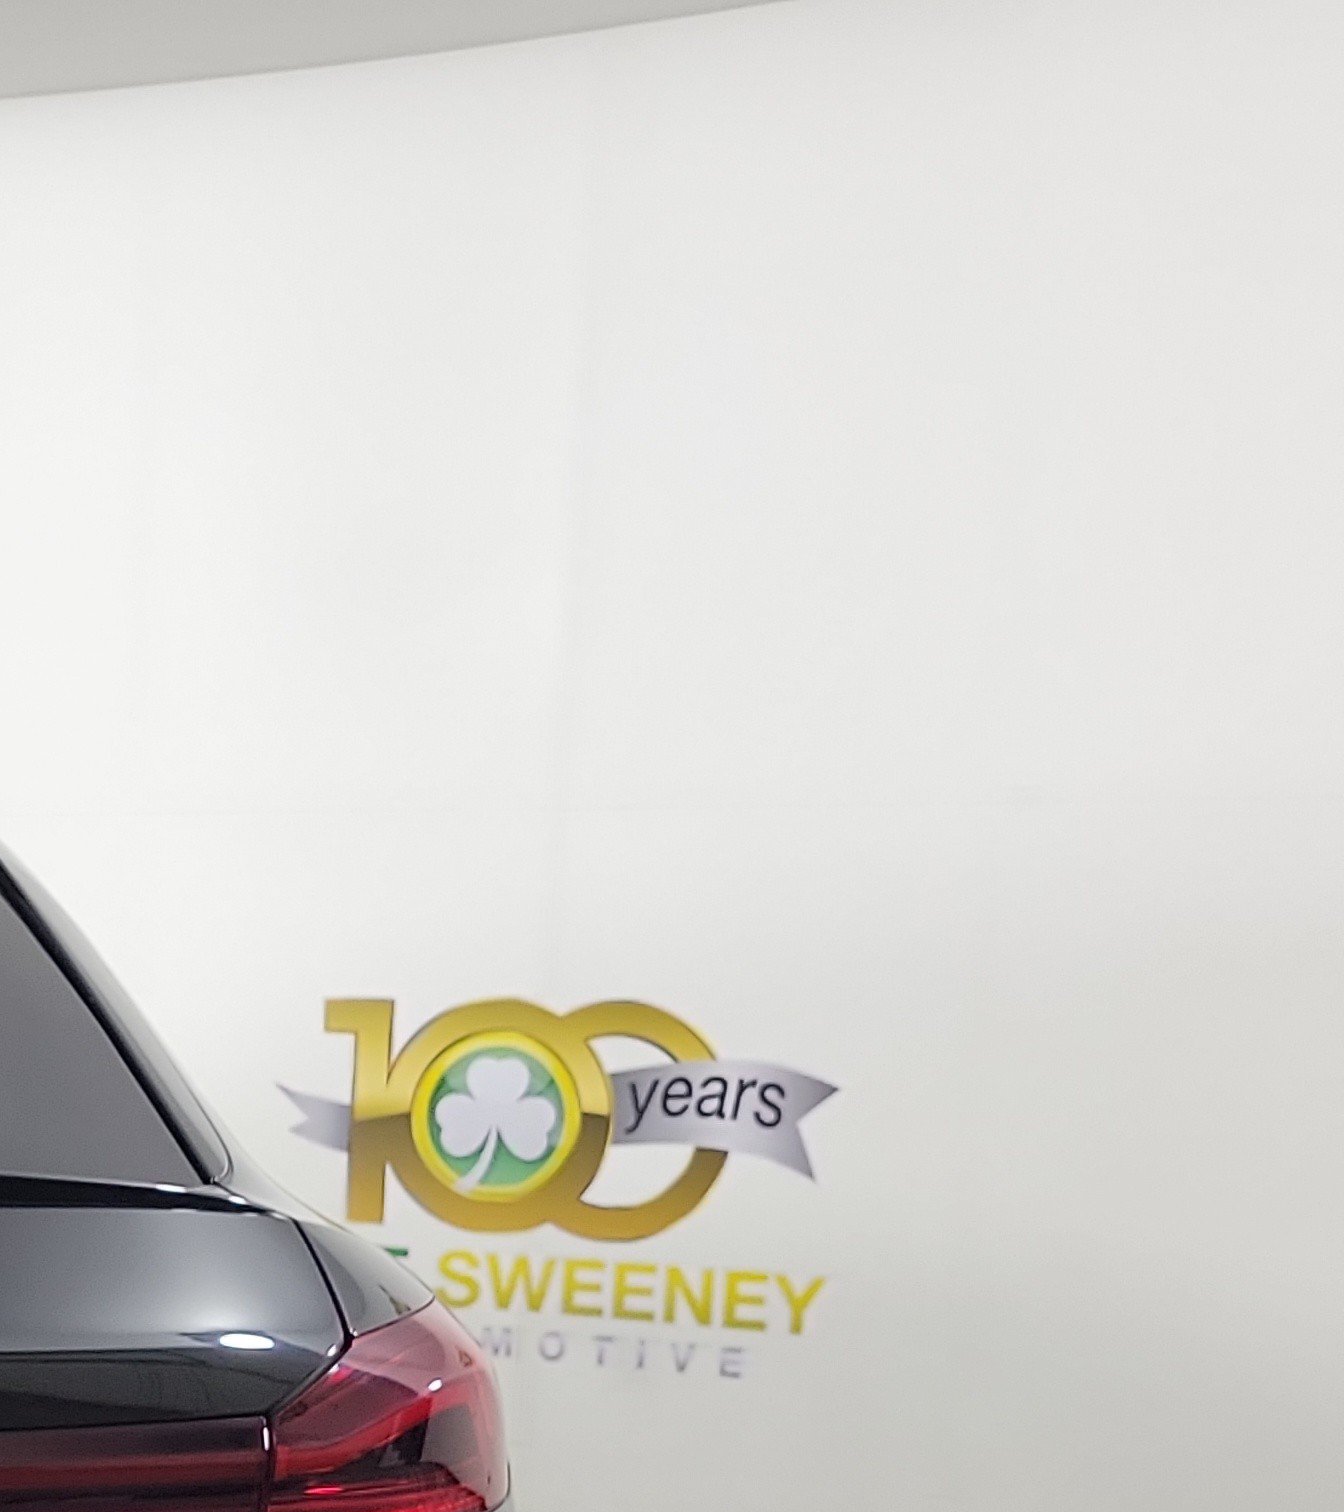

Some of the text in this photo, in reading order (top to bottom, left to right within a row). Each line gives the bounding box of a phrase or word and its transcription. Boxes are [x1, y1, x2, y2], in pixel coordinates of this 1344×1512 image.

[324, 996, 787, 1243] 100 years
[436, 1248, 827, 1335] SWEENEY
